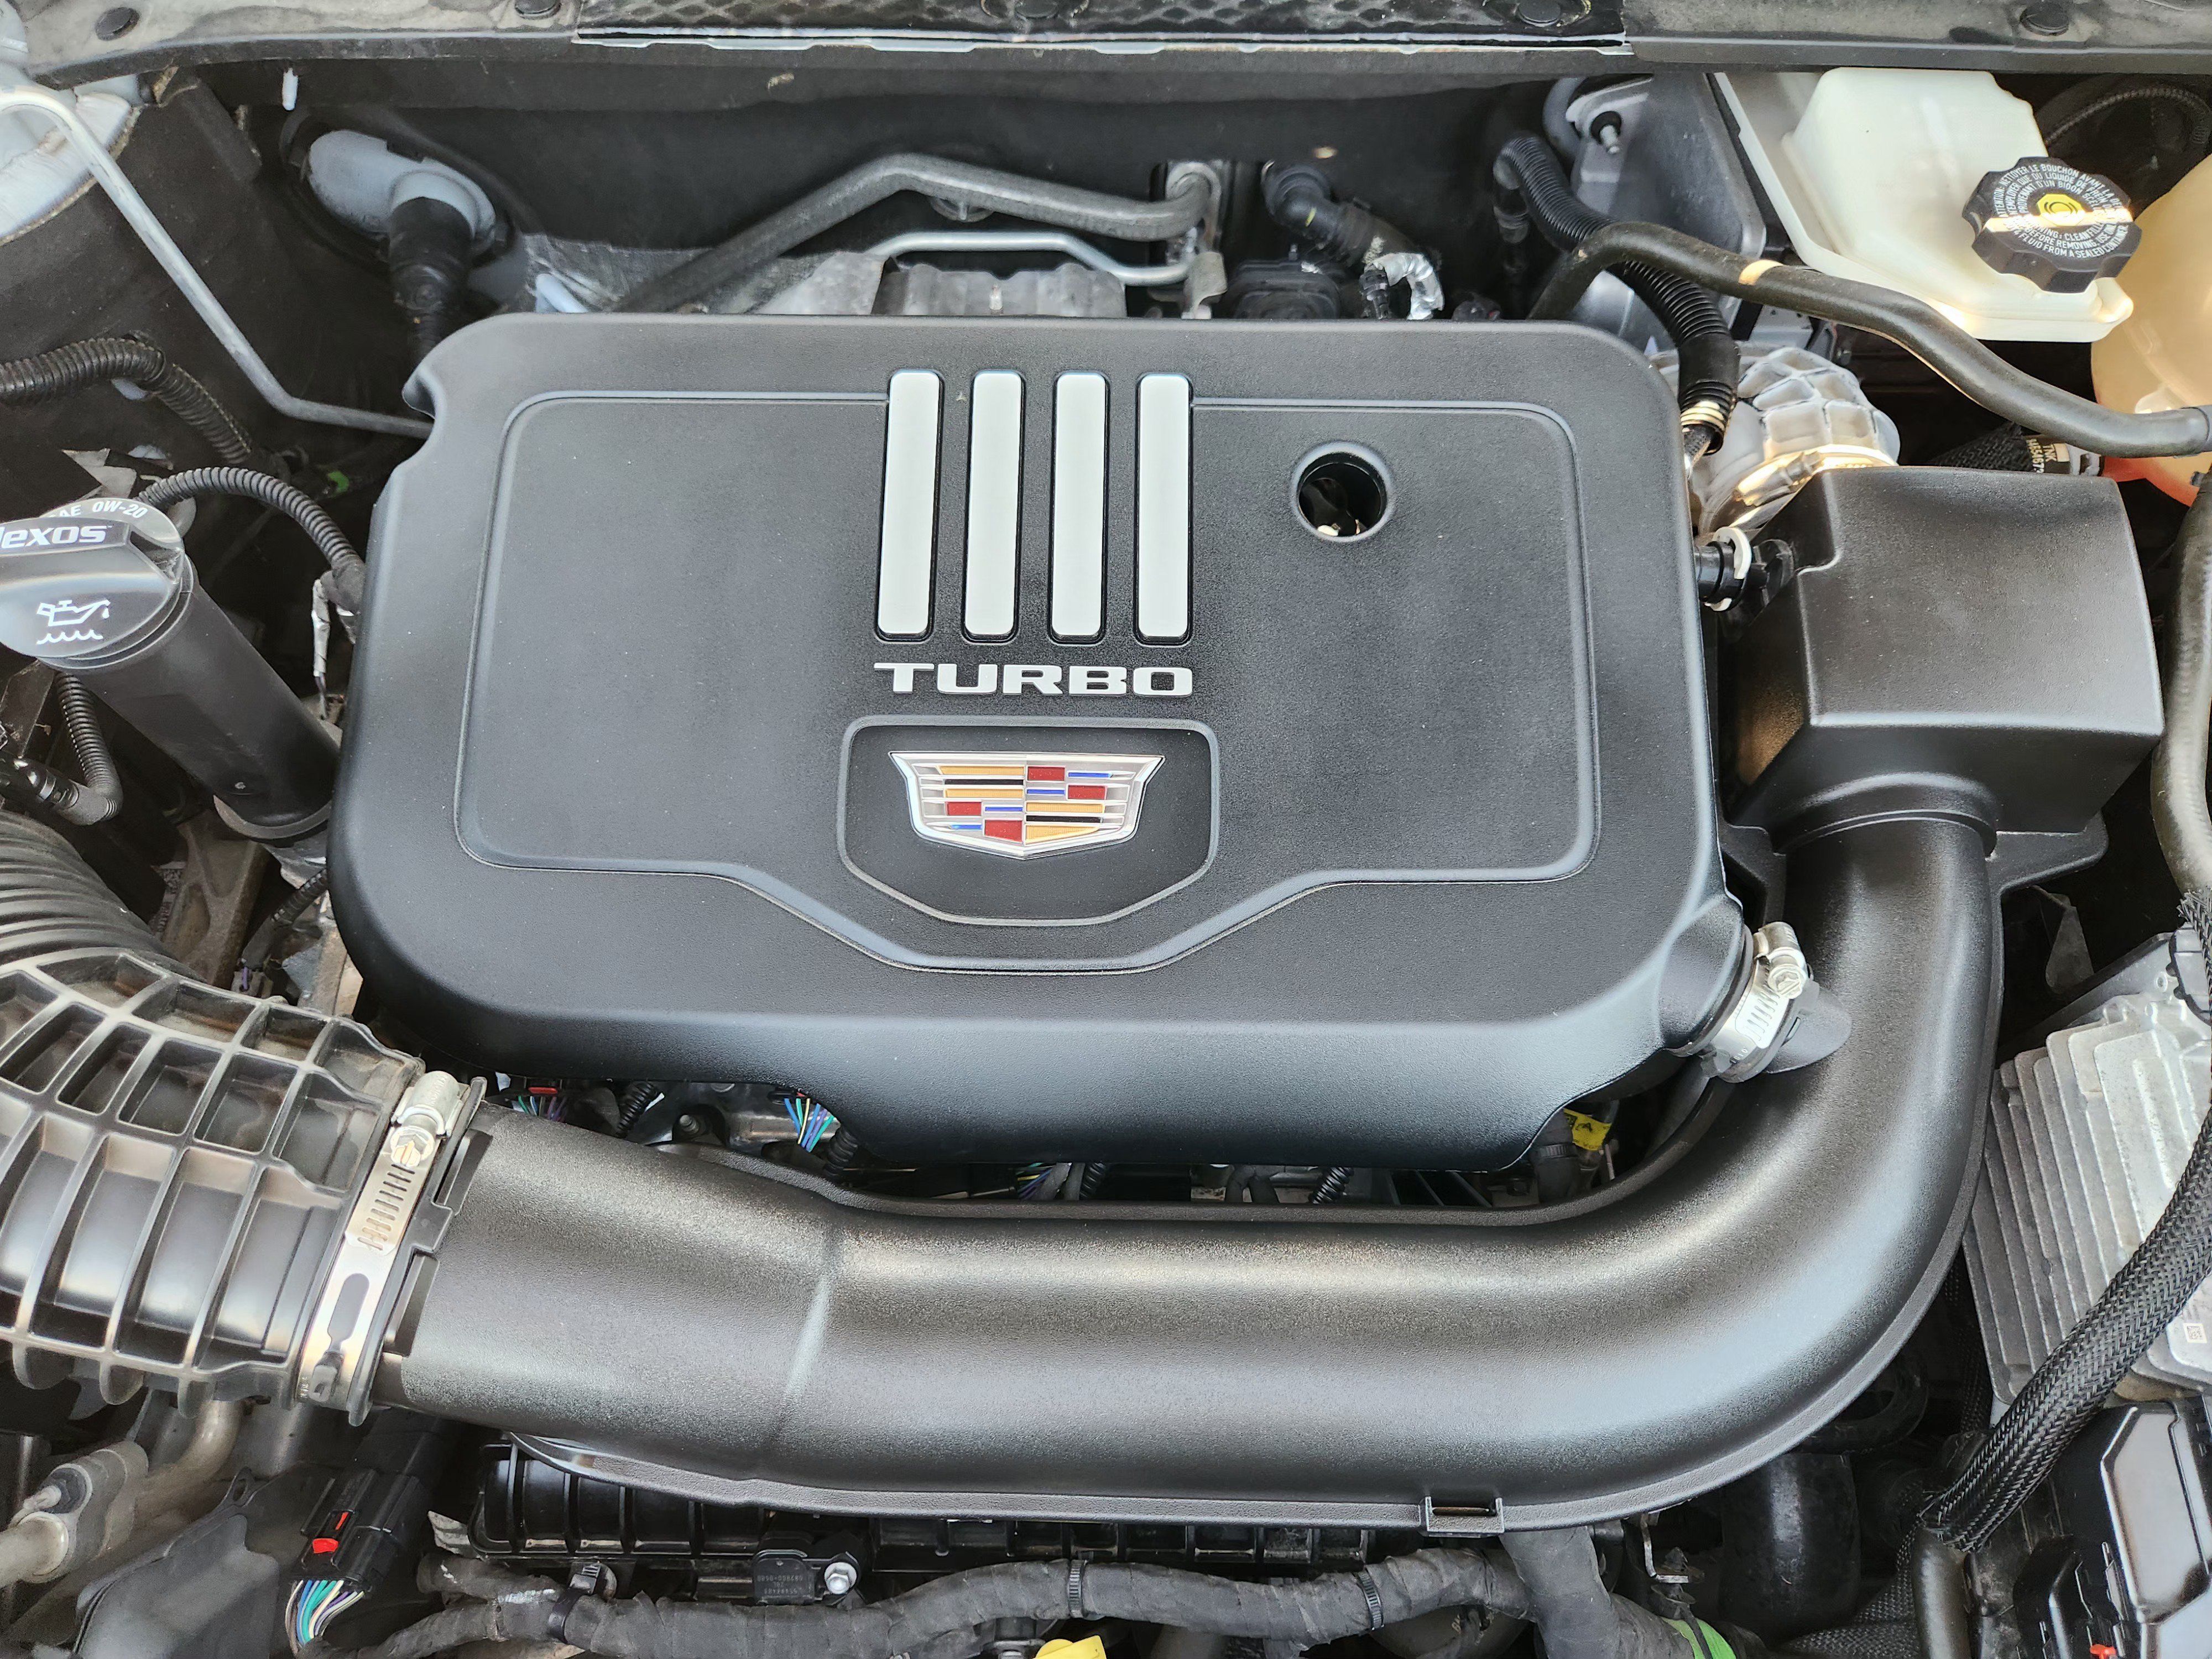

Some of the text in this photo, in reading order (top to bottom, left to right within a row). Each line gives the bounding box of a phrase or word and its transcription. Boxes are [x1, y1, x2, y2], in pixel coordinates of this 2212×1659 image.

[2000, 166, 2028, 185] NETTOYER
[2041, 164, 2079, 176] BOUCHON
[2079, 174, 2105, 190] AVANT
[2102, 189, 2115, 197] LA
[2017, 175, 2032, 185] QUE
[2045, 172, 2075, 184] LIQUIDE
[2075, 180, 2088, 189] DE
[2086, 186, 2108, 203] FREIN
[2017, 184, 2036, 213] PROVENANT
[2058, 181, 2083, 195] BIDON
[2018, 233, 2043, 248] FLUID
[2043, 245, 2066, 256] FROM
[2068, 249, 2075, 257] A
[2075, 247, 2106, 258] SEALED
[2025, 226, 2055, 244] BEFORE
[2095, 232, 2110, 243] USE
[2043, 444, 2057, 462] TNK
[49, 500, 148, 519] AE 0W-20
[874, 662, 1193, 696] TURBO
